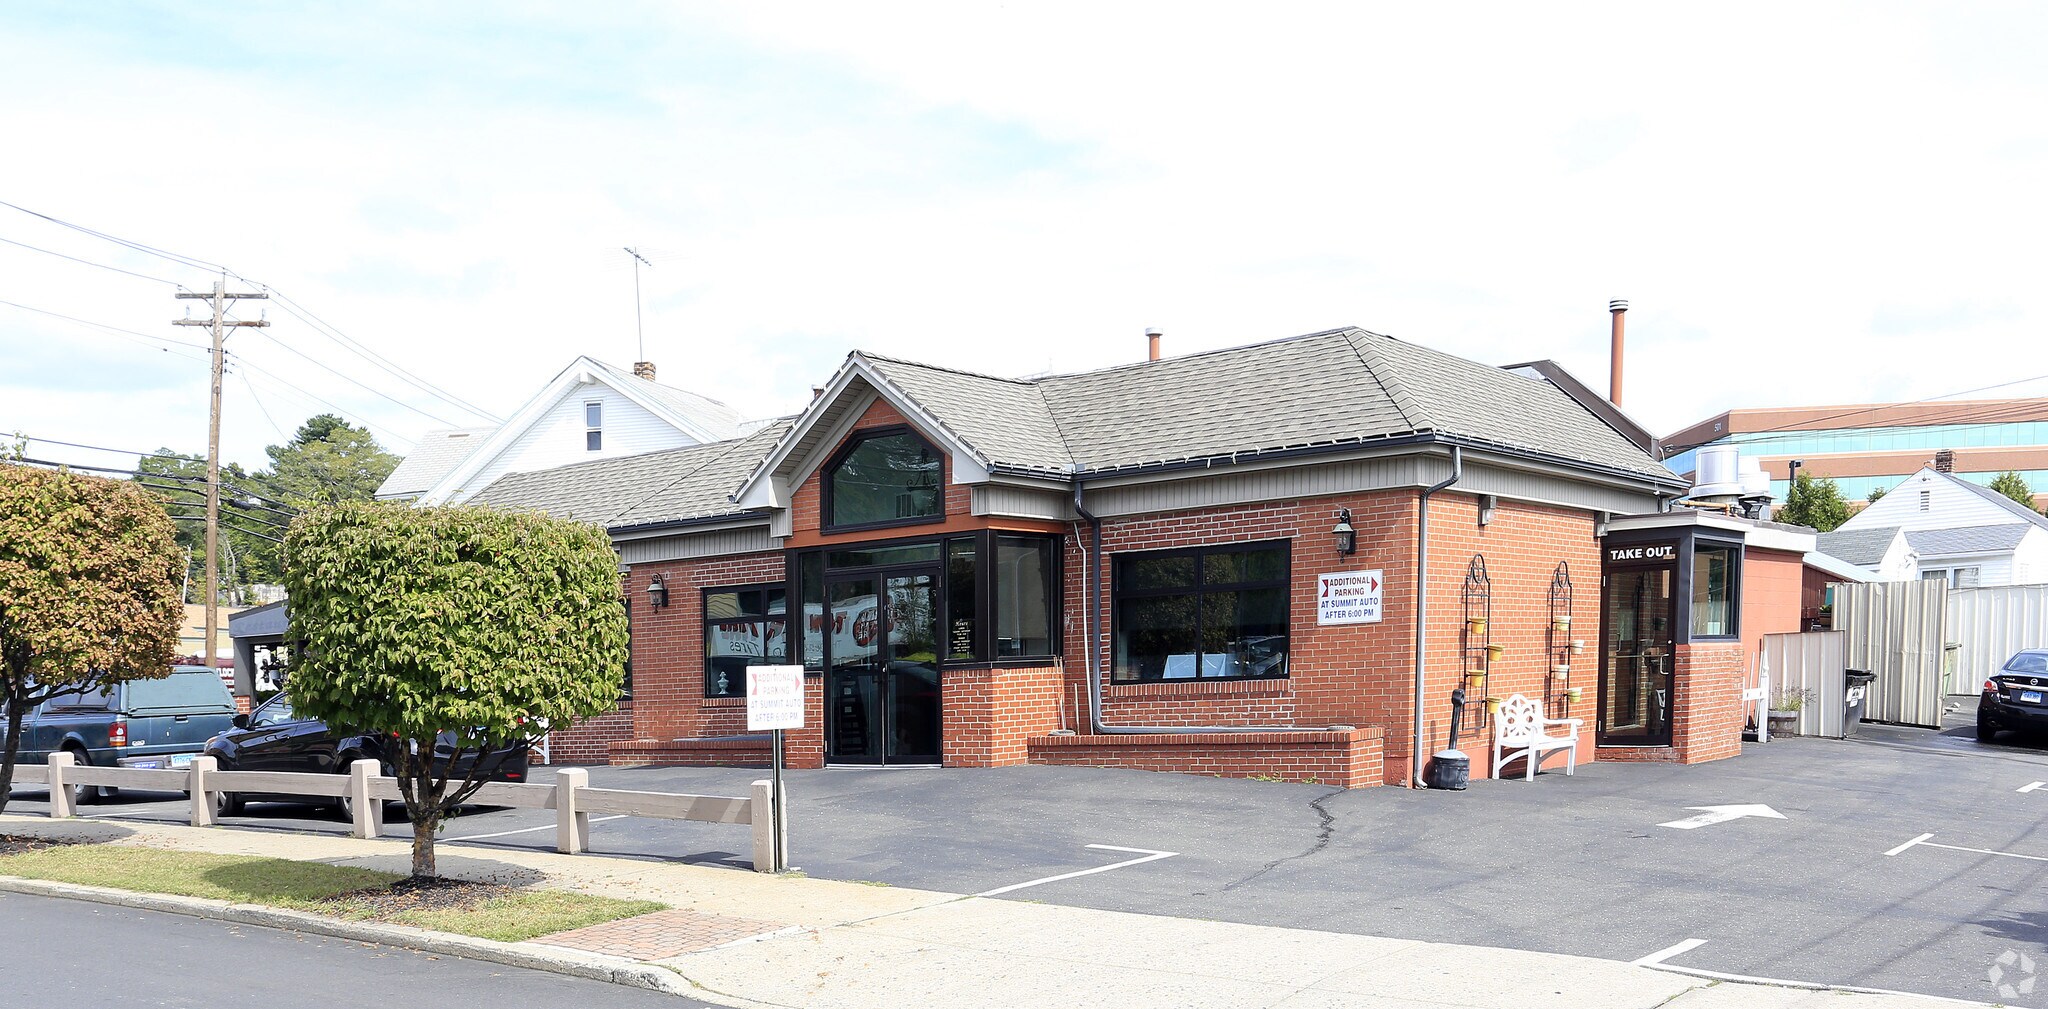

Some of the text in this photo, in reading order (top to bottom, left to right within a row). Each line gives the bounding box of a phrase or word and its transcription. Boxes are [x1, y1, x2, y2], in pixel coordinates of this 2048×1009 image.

[1610, 546, 1673, 560] TAKE OUT
[1330, 576, 1370, 586] ADDITIONAL
[1334, 588, 1364, 597] PARKING
[1321, 597, 1378, 609] AT SUMMIT AUTO
[1325, 608, 1374, 619] AFTER 6:00 PM
